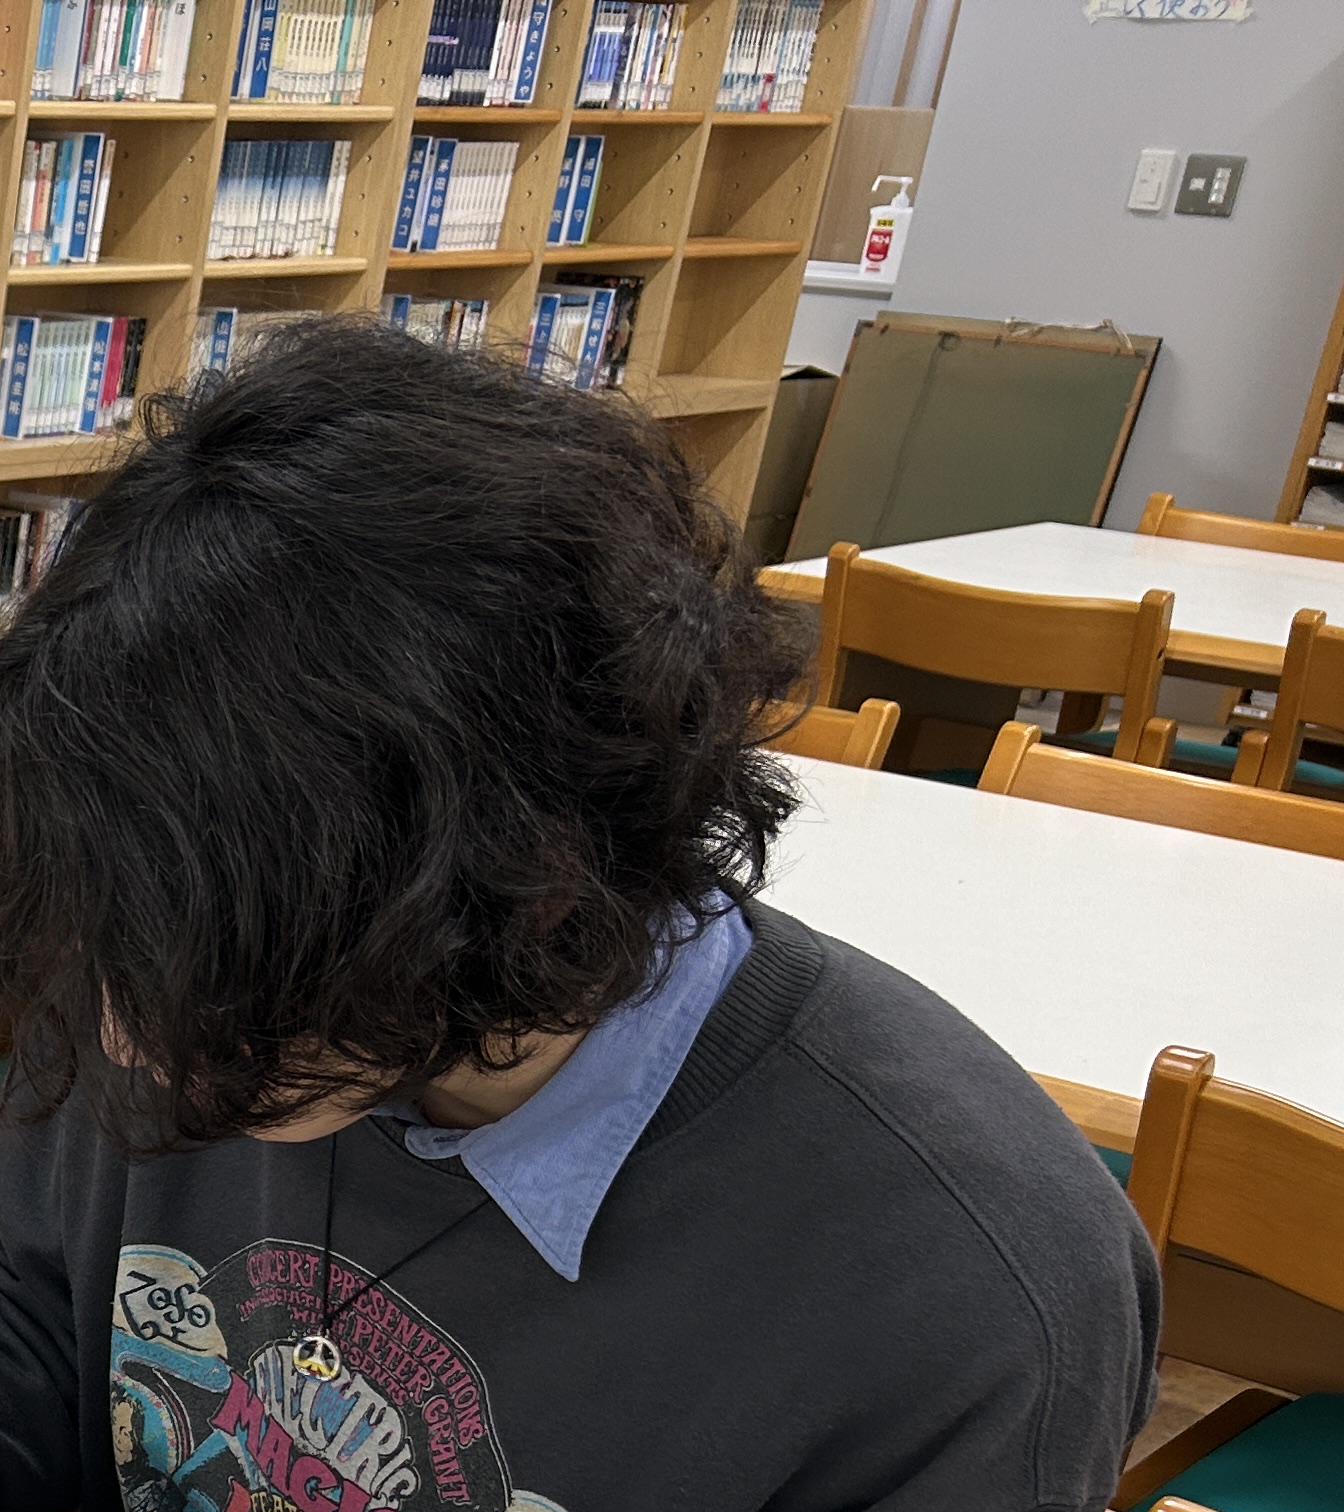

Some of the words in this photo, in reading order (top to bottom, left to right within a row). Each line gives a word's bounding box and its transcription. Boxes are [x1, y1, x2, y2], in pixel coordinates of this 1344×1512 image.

[327, 1265, 486, 1449] PRESENTATIONS
[347, 1314, 435, 1405] PETER
[423, 1393, 471, 1505] GRANT
